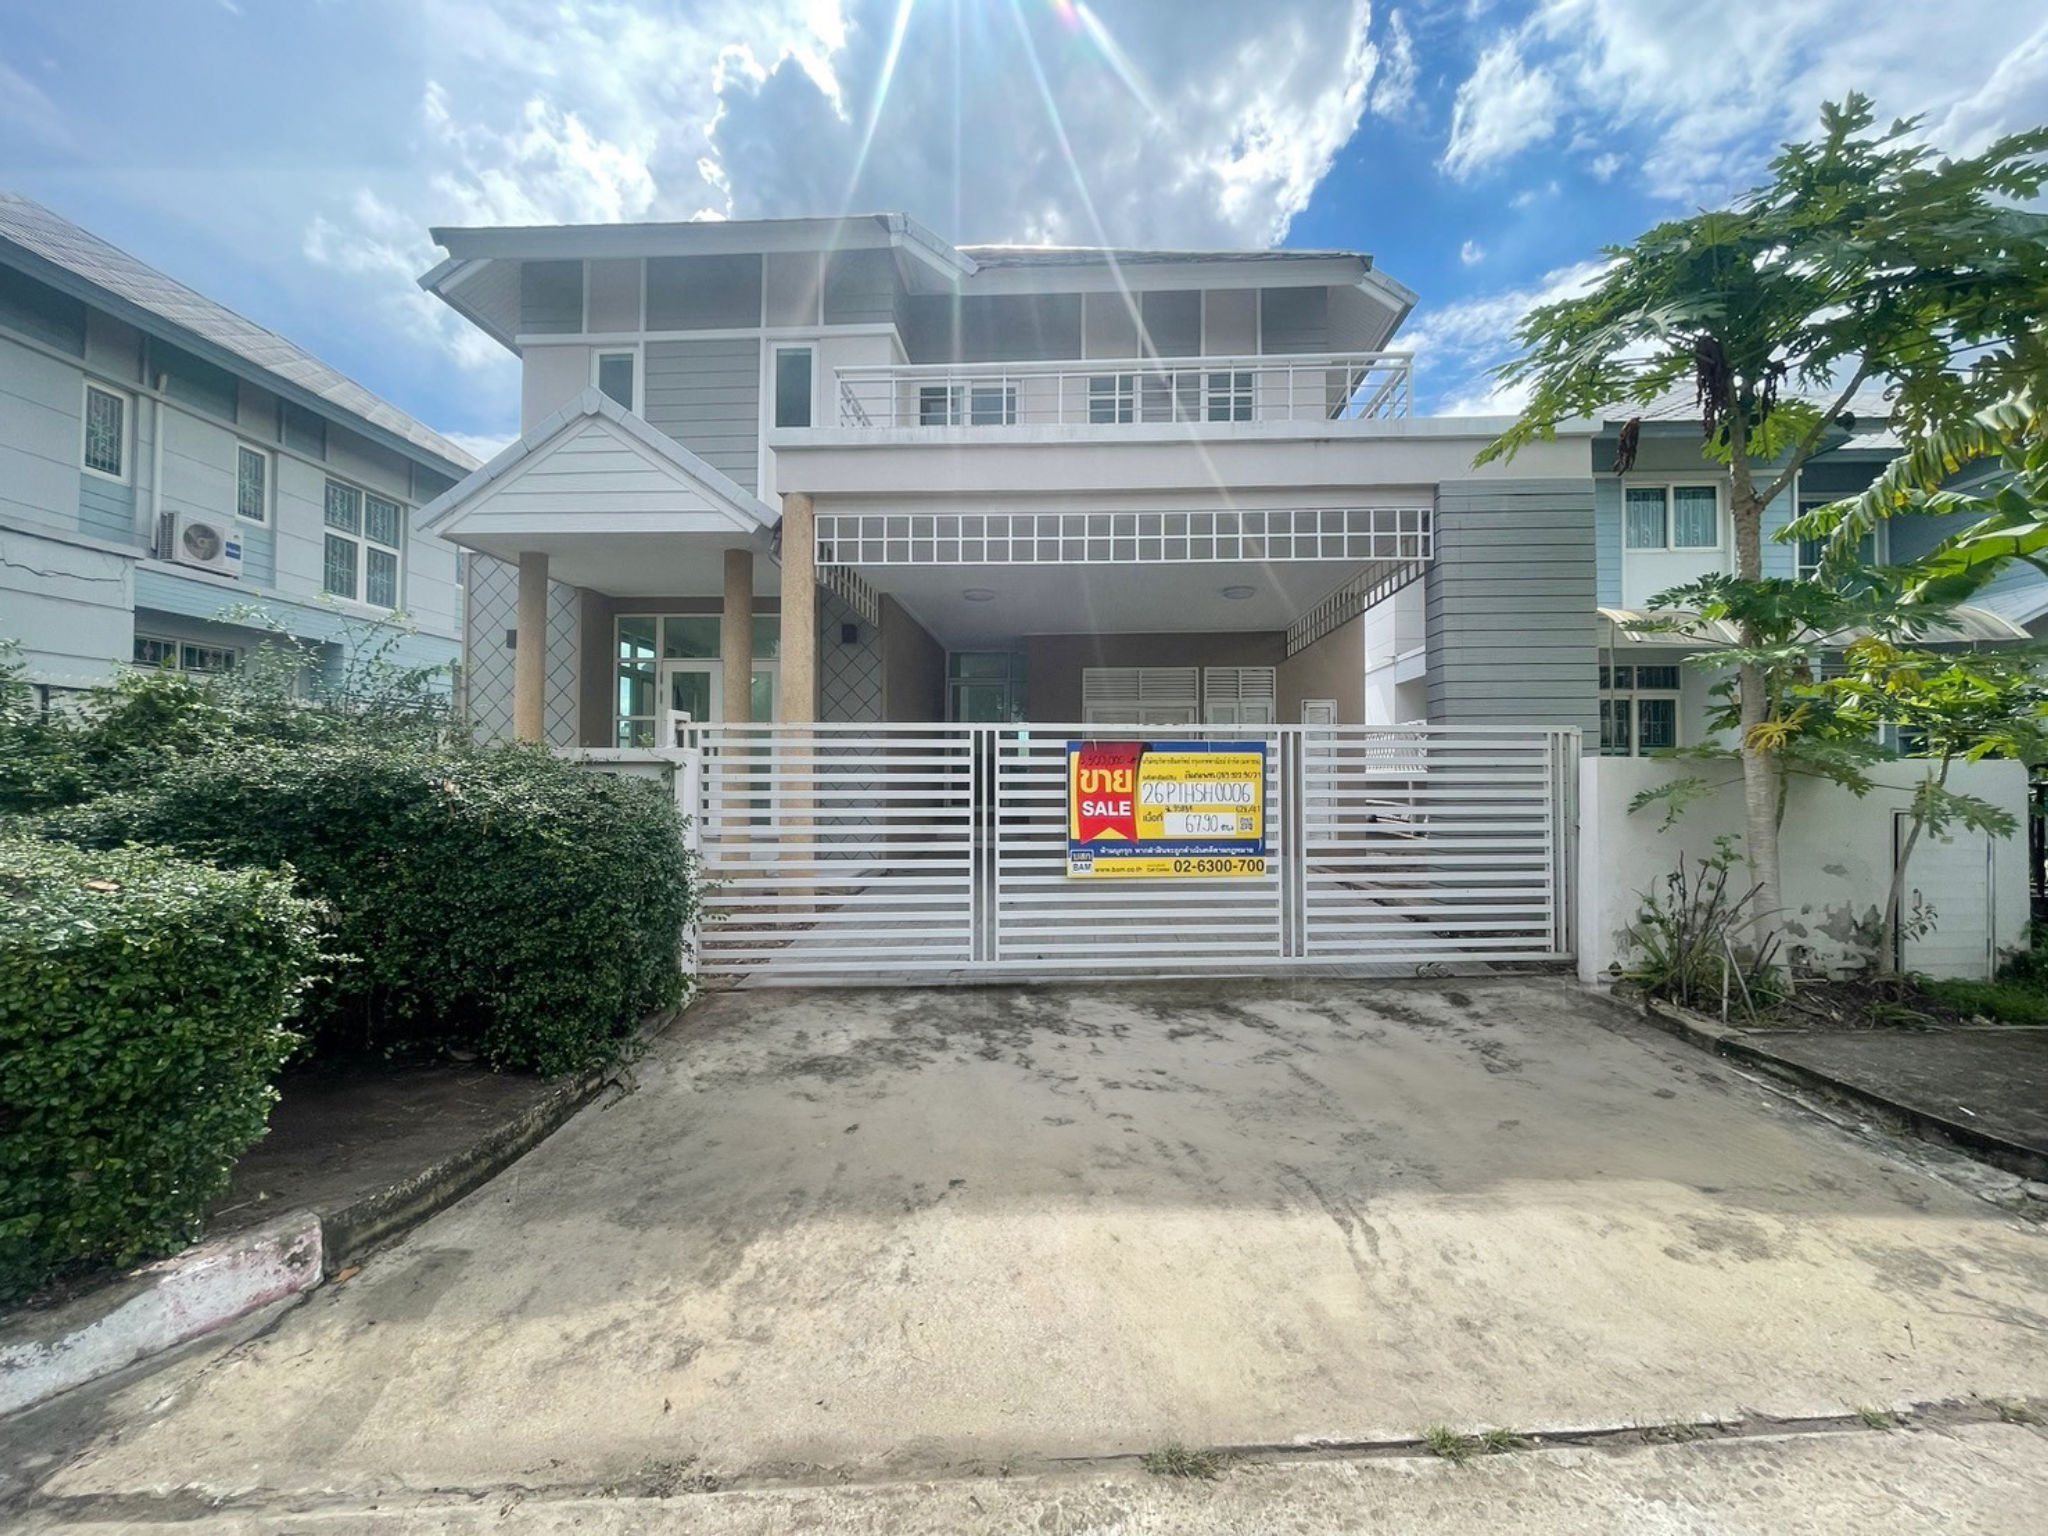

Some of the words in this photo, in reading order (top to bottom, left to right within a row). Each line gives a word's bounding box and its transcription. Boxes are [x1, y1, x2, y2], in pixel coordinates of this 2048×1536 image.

[1080, 769, 1133, 793] ขาย
[1082, 801, 1131, 817] SALE
[1073, 863, 1092, 873] BAM
[1174, 859, 1265, 873] 02-6300-700
